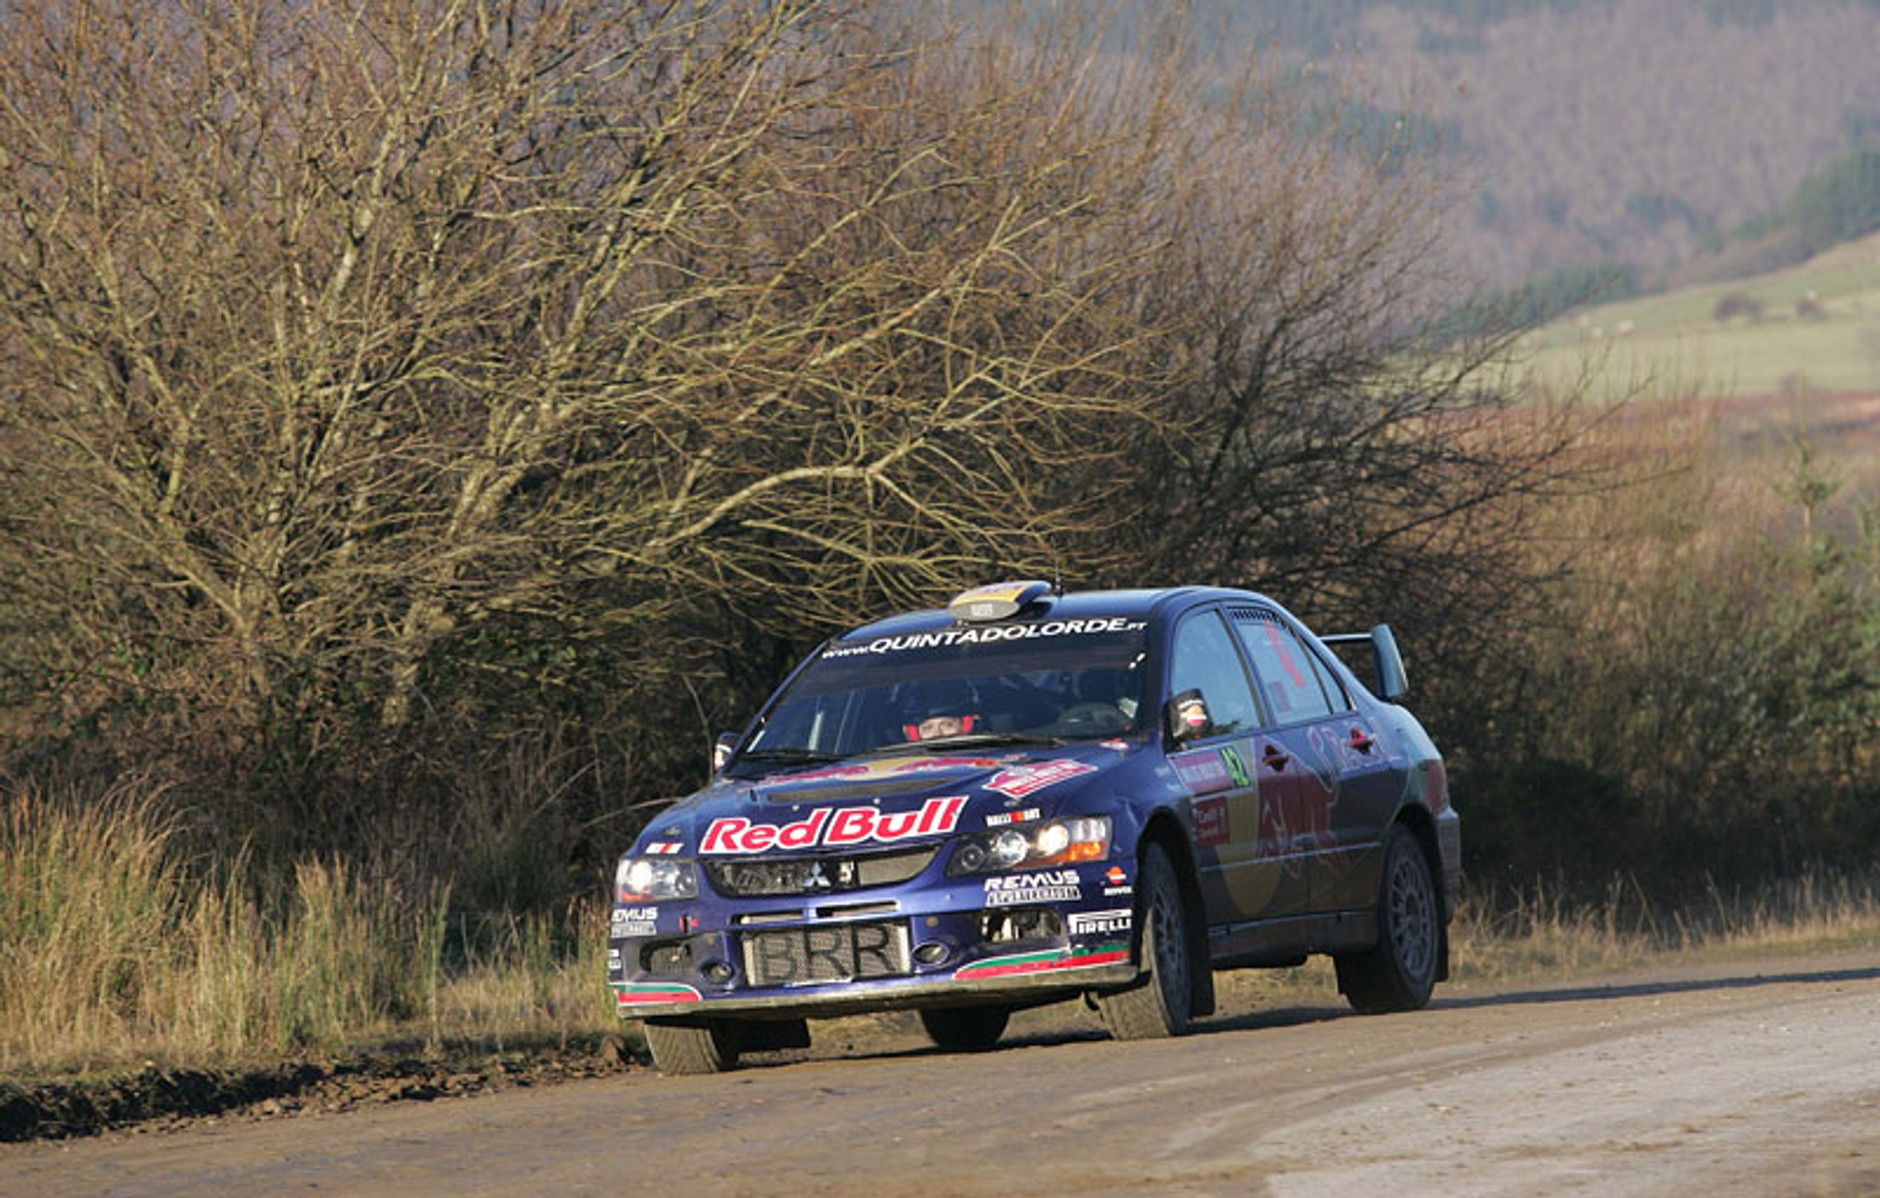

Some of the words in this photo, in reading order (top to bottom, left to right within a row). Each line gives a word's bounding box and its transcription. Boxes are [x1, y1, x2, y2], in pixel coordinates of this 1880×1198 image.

[699, 808, 834, 854] Red
[822, 796, 969, 845] Bull
[984, 870, 1080, 892] REMUS
[1067, 909, 1132, 935] PIRELLI
[758, 923, 898, 981] BRR
